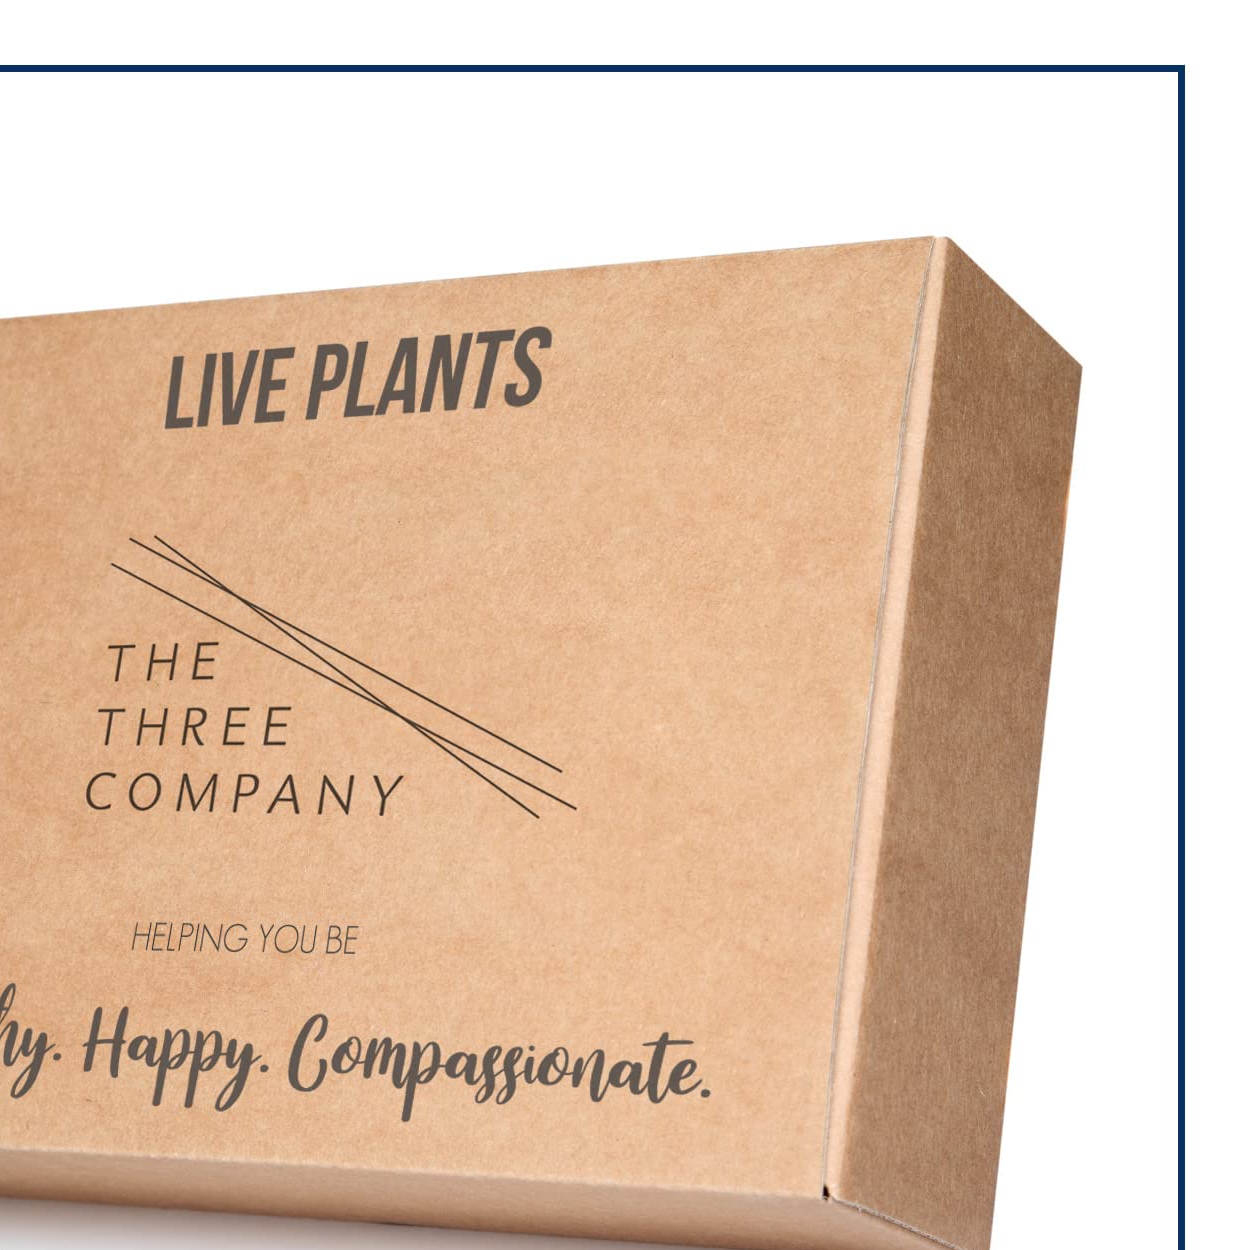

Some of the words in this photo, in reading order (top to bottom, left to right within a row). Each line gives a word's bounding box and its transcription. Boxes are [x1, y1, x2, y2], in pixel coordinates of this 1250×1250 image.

[164, 346, 296, 431] LIVE
[304, 325, 553, 422] PLANTS
[107, 641, 220, 683] THE
[97, 706, 293, 747] THREE
[84, 771, 405, 818] COMPANY
[131, 920, 249, 954] HELPING
[258, 922, 319, 955] YOU
[324, 923, 359, 956] BE
[81, 1005, 271, 1113] Happy.
[286, 1012, 713, 1124] Compassionate.
